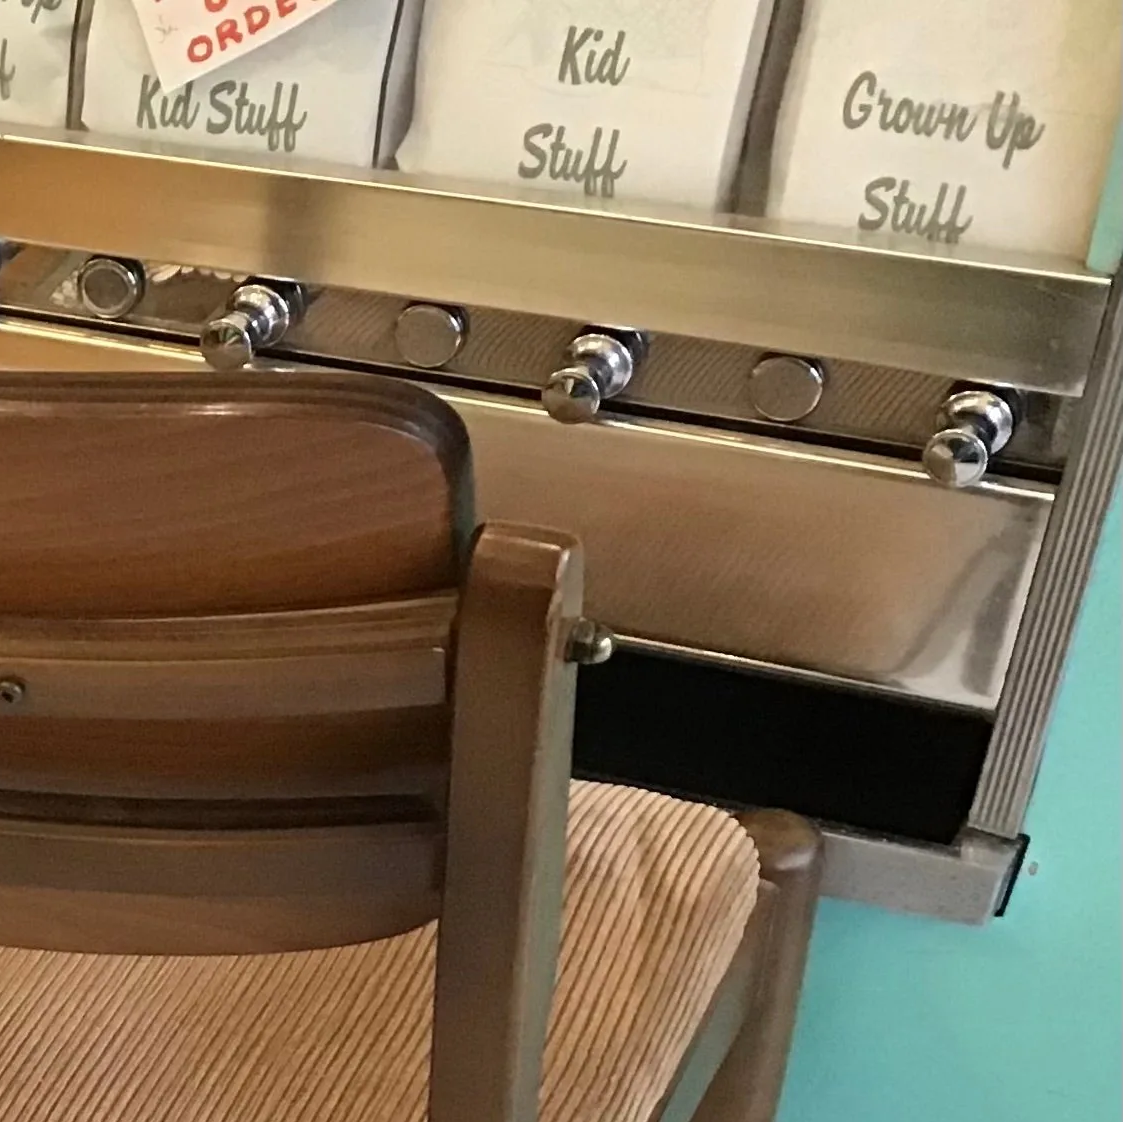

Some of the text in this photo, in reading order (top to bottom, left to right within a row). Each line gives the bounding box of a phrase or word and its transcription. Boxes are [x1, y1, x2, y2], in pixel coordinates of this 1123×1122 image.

[187, 0, 318, 63] ORDE
[558, 25, 630, 86] Kid
[136, 74, 308, 151] Kid Stuff
[842, 70, 1046, 170] Grown Up
[517, 123, 628, 198] Stuff
[858, 176, 973, 244] Stuff
